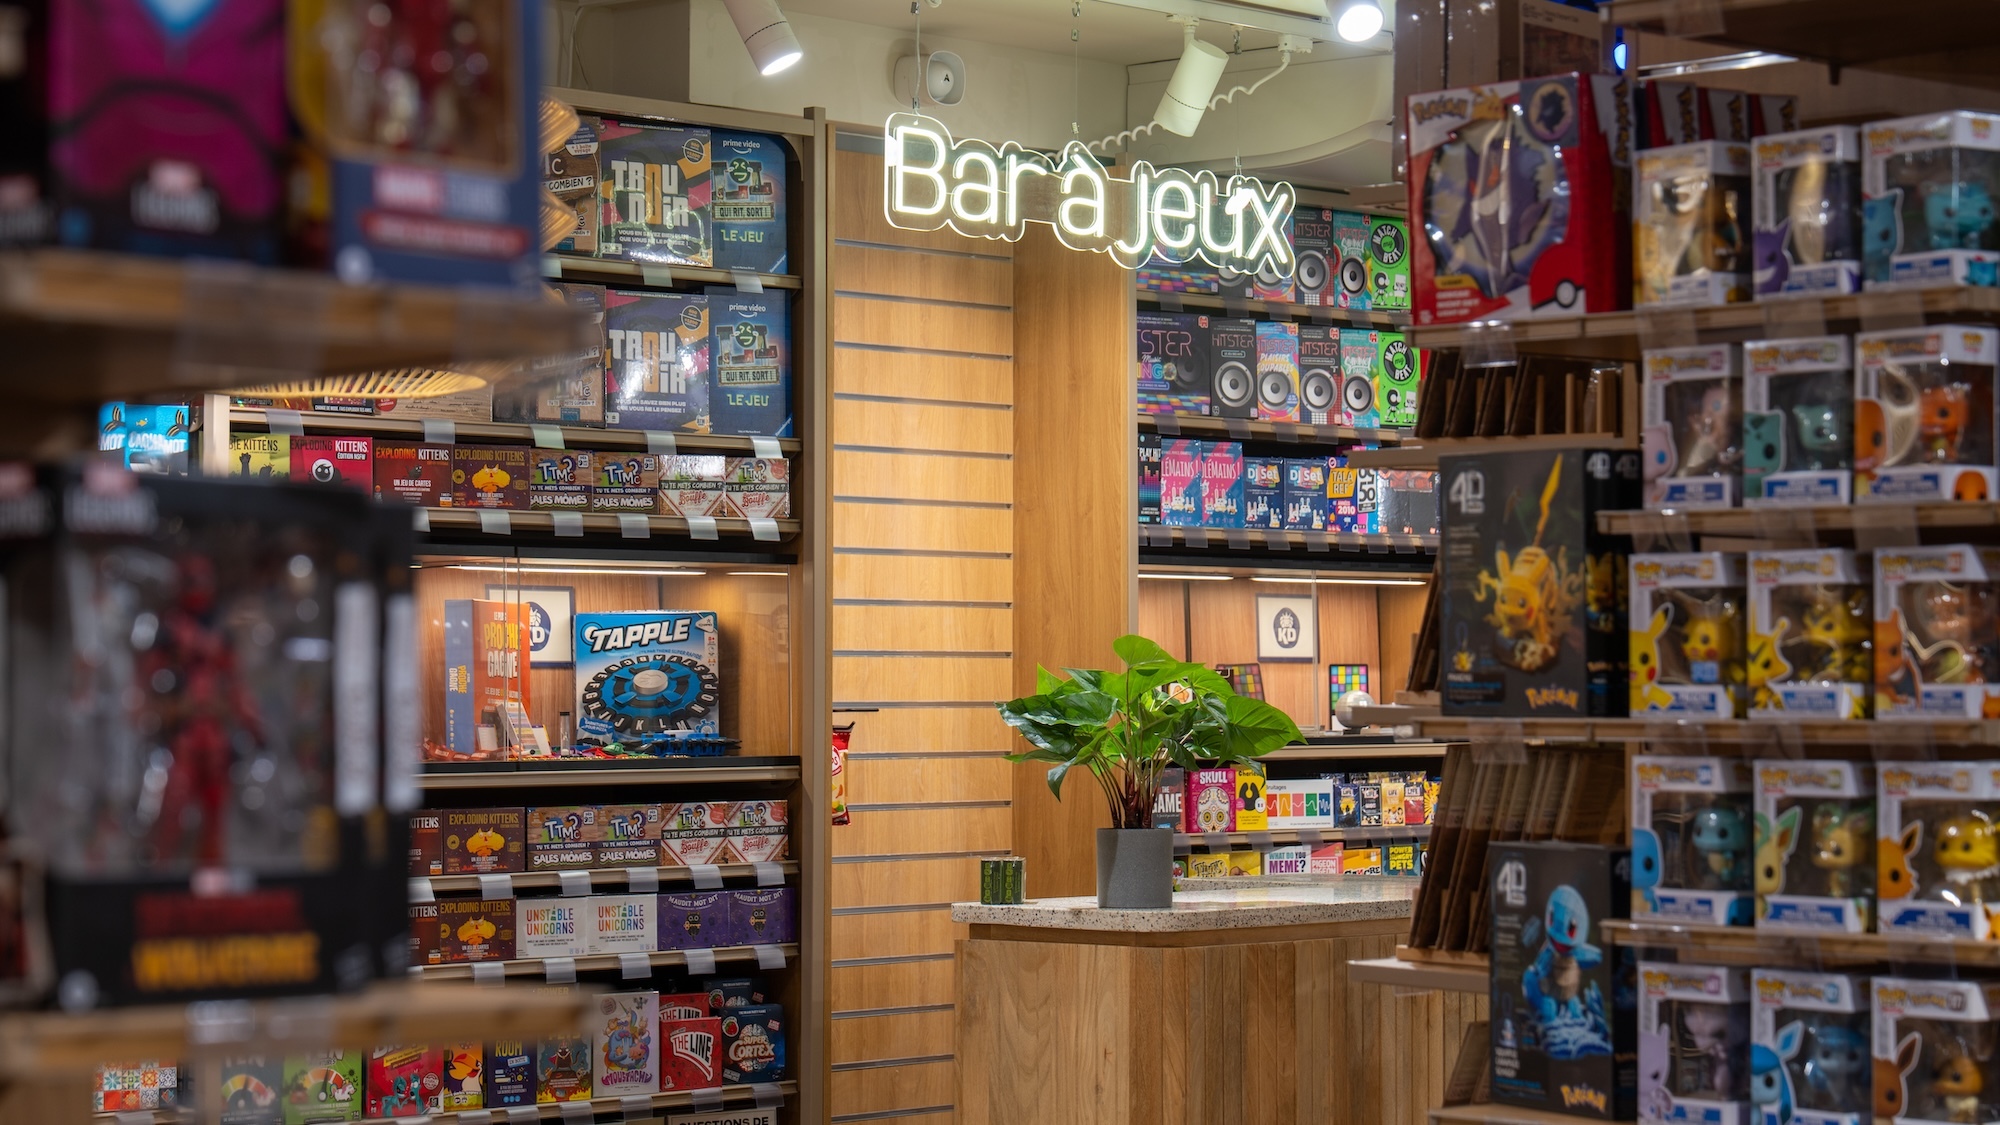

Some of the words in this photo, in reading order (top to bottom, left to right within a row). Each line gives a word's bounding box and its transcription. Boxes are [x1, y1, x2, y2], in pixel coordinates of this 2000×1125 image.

[722, 139, 742, 148] prime
[742, 140, 761, 149] video
[548, 178, 584, 191] COMBIEN
[585, 176, 593, 186] ?
[894, 124, 1048, 227] Bar
[1059, 154, 1105, 238] à
[1114, 174, 1289, 263] jeux
[719, 207, 733, 218] QUI
[746, 207, 763, 218] SORT
[720, 229, 739, 242] LE
[739, 230, 765, 243] JEU
[1372, 225, 1398, 245] MATCH
[1383, 247, 1402, 264] BEAT
[728, 303, 748, 313] prime
[748, 304, 767, 313] video
[1211, 333, 1255, 349] HITSTER
[1259, 353, 1291, 363] PLAISIRS
[1384, 341, 1408, 362] MATCH
[726, 370, 737, 382] QUI
[752, 370, 769, 382] SORT
[1394, 365, 1413, 381] BEAT
[726, 393, 744, 407] LE
[744, 394, 770, 407] JEU
[243, 438, 279, 452] KITTENS
[290, 438, 333, 451] EXPLODING
[335, 440, 369, 453] KITTENS
[375, 447, 417, 460] EXPLODING
[418, 448, 450, 461] KITTENS
[454, 448, 494, 461] EXPLODING
[494, 450, 525, 461] KITTENS
[1260, 467, 1278, 480] Set
[1303, 470, 1322, 482] Set
[1332, 471, 1354, 483] TALA
[393, 479, 401, 487] UN
[400, 479, 409, 487] JEU
[408, 479, 415, 487] DE
[414, 479, 432, 488] CARTES
[677, 482, 691, 490] METS
[691, 481, 717, 490] COMBIEN
[754, 484, 780, 492] COMBIEN
[1333, 482, 1350, 495] REF
[530, 494, 553, 505] SALES
[553, 492, 588, 505] MÔMES
[1359, 487, 1376, 502] 50
[593, 498, 619, 508] SALES
[619, 496, 654, 507] MÔMES
[1337, 505, 1356, 515] 2010
[591, 618, 692, 653] TAPPLE
[1277, 627, 1298, 645] KD
[448, 667, 458, 692] GAGNE
[457, 665, 468, 694] PROCHE
[1199, 770, 1228, 785] SKULL
[1161, 785, 1171, 794] THE
[408, 816, 440, 829] KITTENS
[449, 813, 489, 826] EXPLODING
[488, 812, 519, 825] KITTENS
[662, 831, 671, 839] TU
[670, 831, 678, 839] TE
[679, 830, 694, 839] METS
[694, 829, 719, 838] COMBIEN
[733, 829, 740, 837] TE
[740, 828, 755, 837] METS
[755, 827, 779, 836] COMBIEN
[600, 850, 625, 862] SALES
[625, 848, 657, 861] MÔMES
[1269, 852, 1285, 860] WHAT
[1285, 851, 1294, 859] DO
[1295, 851, 1307, 859] YOU
[1389, 845, 1413, 855] POWER
[533, 852, 559, 865] SALES
[560, 850, 593, 863] MÔMES
[1311, 858, 1337, 869] PIGEON
[1269, 859, 1307, 874] MEME?
[1389, 860, 1414, 871] PETS
[667, 895, 692, 907] MAUDIT
[693, 898, 707, 908] MOT
[707, 893, 719, 904] DIT
[733, 892, 757, 904] MAUDIT
[758, 894, 772, 903] MOT
[773, 890, 784, 900] DIT
[408, 905, 439, 918] KITTENS
[440, 900, 480, 914] EXPLODING
[480, 900, 512, 913] KITTENS
[526, 905, 574, 922] UNSTABLE
[597, 903, 645, 919] UNSTABLE
[526, 921, 575, 936] UNICORNS
[597, 918, 645, 932] UNICORNS
[660, 1009, 677, 1020] THE
[743, 1035, 766, 1044] SUPER
[495, 1039, 523, 1058] ROOM
[673, 1034, 690, 1051] THE
[689, 1034, 712, 1063] LINE
[728, 1039, 776, 1062] CORTEX
[753, 1116, 769, 1125] DE
